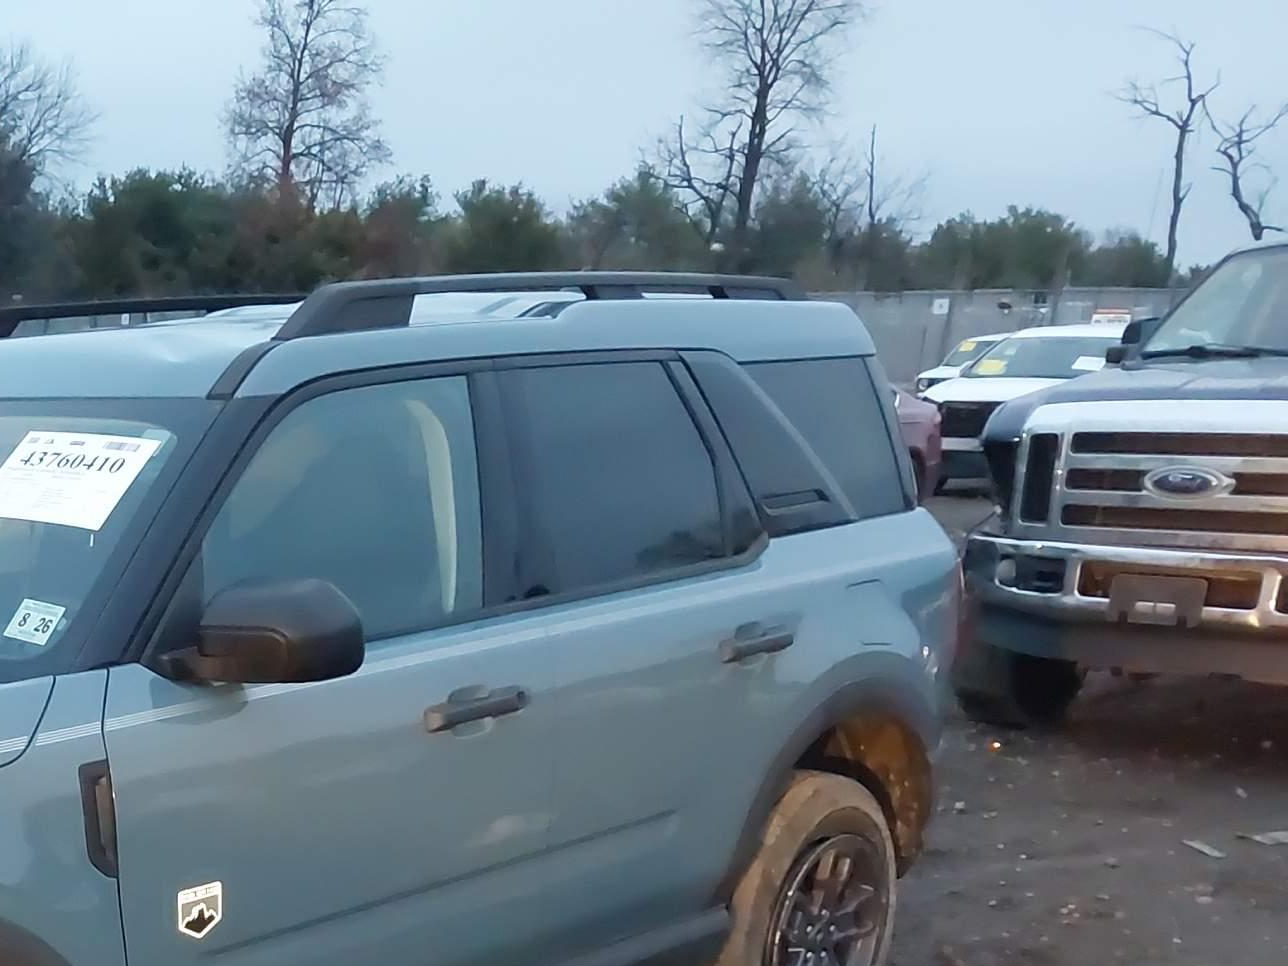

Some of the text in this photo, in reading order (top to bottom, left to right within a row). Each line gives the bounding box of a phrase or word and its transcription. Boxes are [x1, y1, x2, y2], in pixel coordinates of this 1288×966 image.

[20, 451, 126, 474] 43760410
[18, 612, 31, 627] 8
[33, 617, 53, 633] 26
